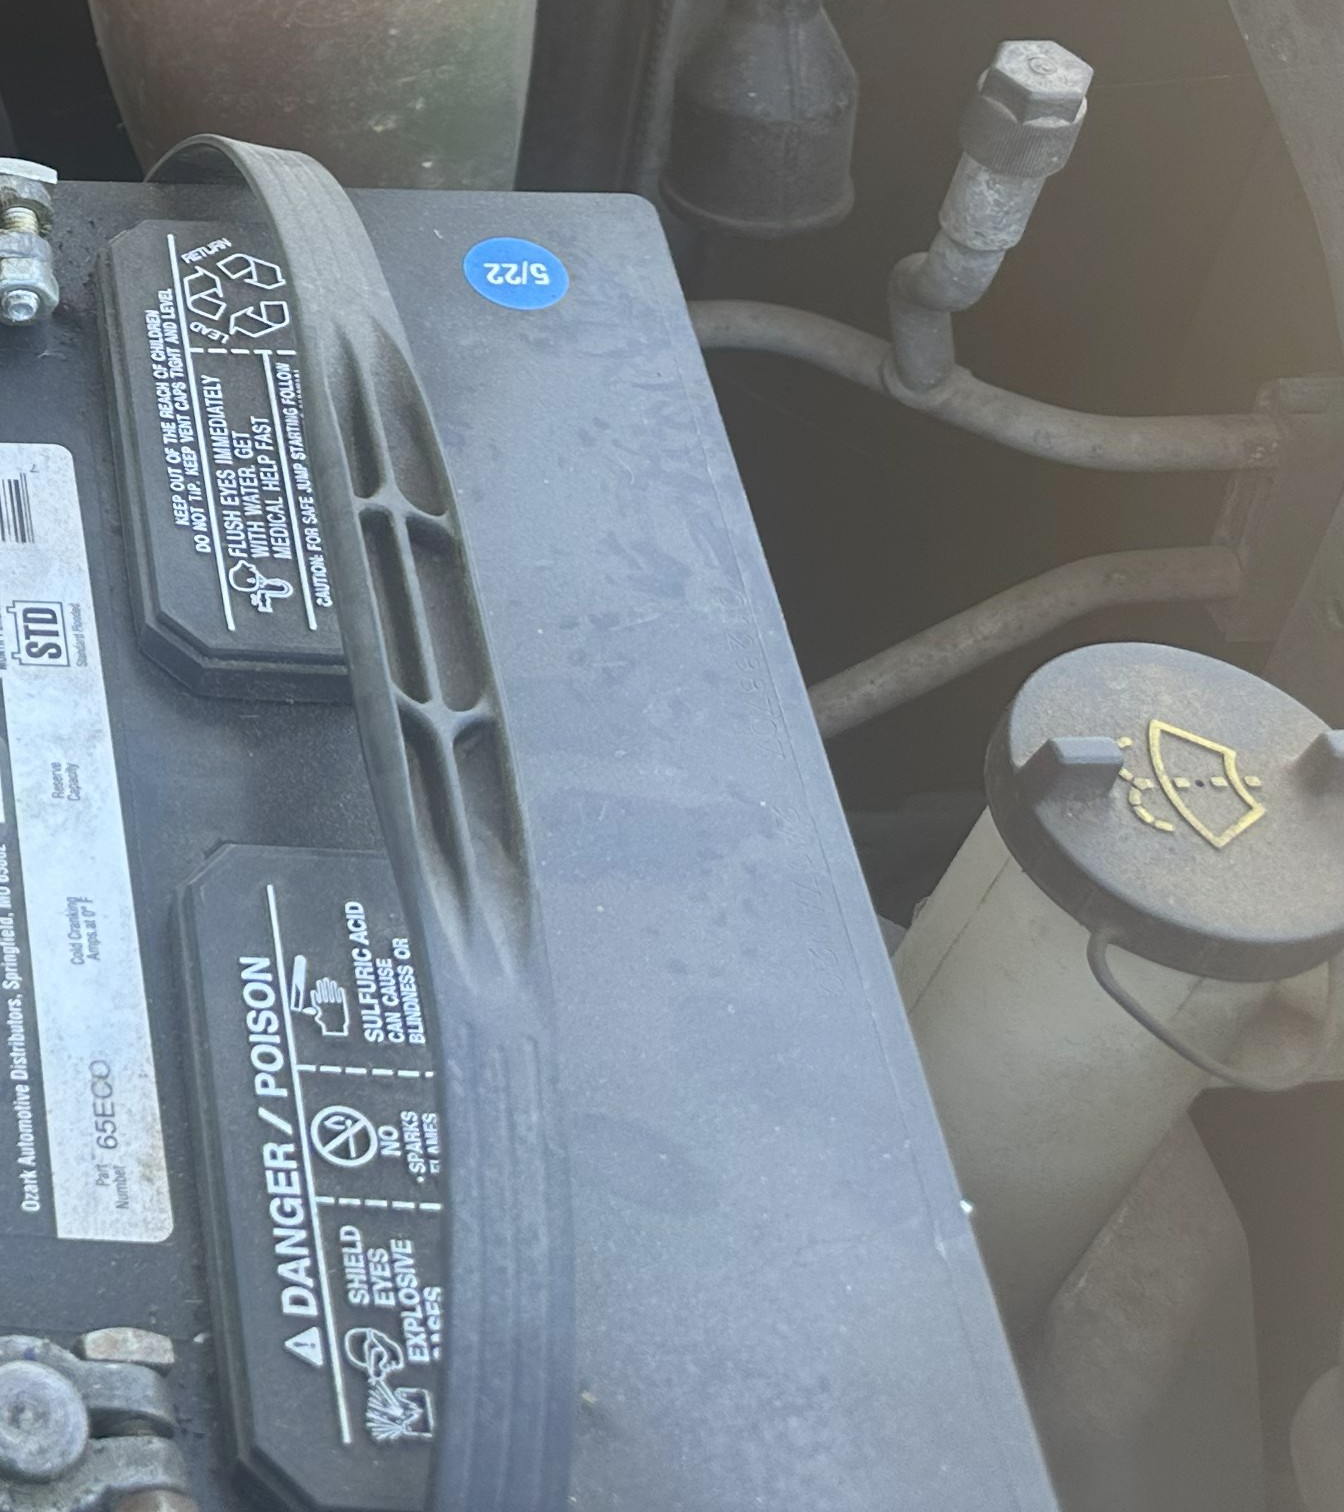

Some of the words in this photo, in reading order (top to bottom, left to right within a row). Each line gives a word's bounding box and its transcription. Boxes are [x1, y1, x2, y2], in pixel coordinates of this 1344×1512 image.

[181, 238, 232, 264] RETURN
[483, 261, 550, 285] 5/22
[158, 288, 176, 319] LEVEL
[145, 310, 165, 361] CHILDREN
[162, 322, 180, 344] AND
[189, 322, 230, 343] LEAD
[152, 362, 168, 379] OF
[166, 348, 184, 377] TIGHT
[155, 382, 175, 418] REACH
[171, 382, 190, 410] CAPS
[276, 362, 298, 405] FOLLOW
[161, 422, 178, 444] THE
[177, 414, 194, 443] VENT
[202, 374, 234, 464] IMMEDIATELY
[251, 416, 274, 450] FAST
[283, 408, 307, 460] STARTING
[165, 446, 181, 464] OF
[182, 446, 200, 476] KEEP
[232, 430, 254, 459] GET
[168, 468, 185, 492] OUT
[187, 480, 204, 501] TIP.
[216, 470, 240, 506] EYES
[260, 455, 280, 492] HELP
[294, 463, 312, 493] JUMP
[170, 494, 190, 525] KEEP
[191, 506, 208, 531] NOT
[269, 496, 292, 559] MEDICAL
[299, 496, 318, 524] SAFE
[194, 534, 212, 552] DO
[223, 510, 248, 558] FLUSH
[247, 521, 270, 558] WITH
[303, 527, 323, 551] FOR
[22, 607, 62, 659] STD
[48, 762, 65, 799] Reserve
[66, 762, 82, 802] Capacity
[64, 896, 86, 939] Cranking
[345, 902, 370, 945] ACID
[69, 942, 86, 965] Cold
[392, 938, 410, 959] OR
[352, 948, 384, 1042] SULFURIC
[376, 958, 400, 1006] CAUSE
[397, 965, 426, 1044] BLINDNESS
[4, 994, 30, 1080] Distributors,
[239, 956, 288, 1098] POISON
[384, 1012, 404, 1043] CAN
[89, 1060, 118, 1150] 65ECO
[10, 1084, 37, 1166] Automotive
[378, 1125, 402, 1157] NO
[400, 1111, 426, 1174] SPARKS
[18, 1170, 41, 1212] Ozark
[262, 1141, 318, 1316] DANGER
[338, 1225, 370, 1306] SHIELD
[367, 1248, 396, 1306] EYES
[390, 1238, 430, 1362] EXPLOSIVE
